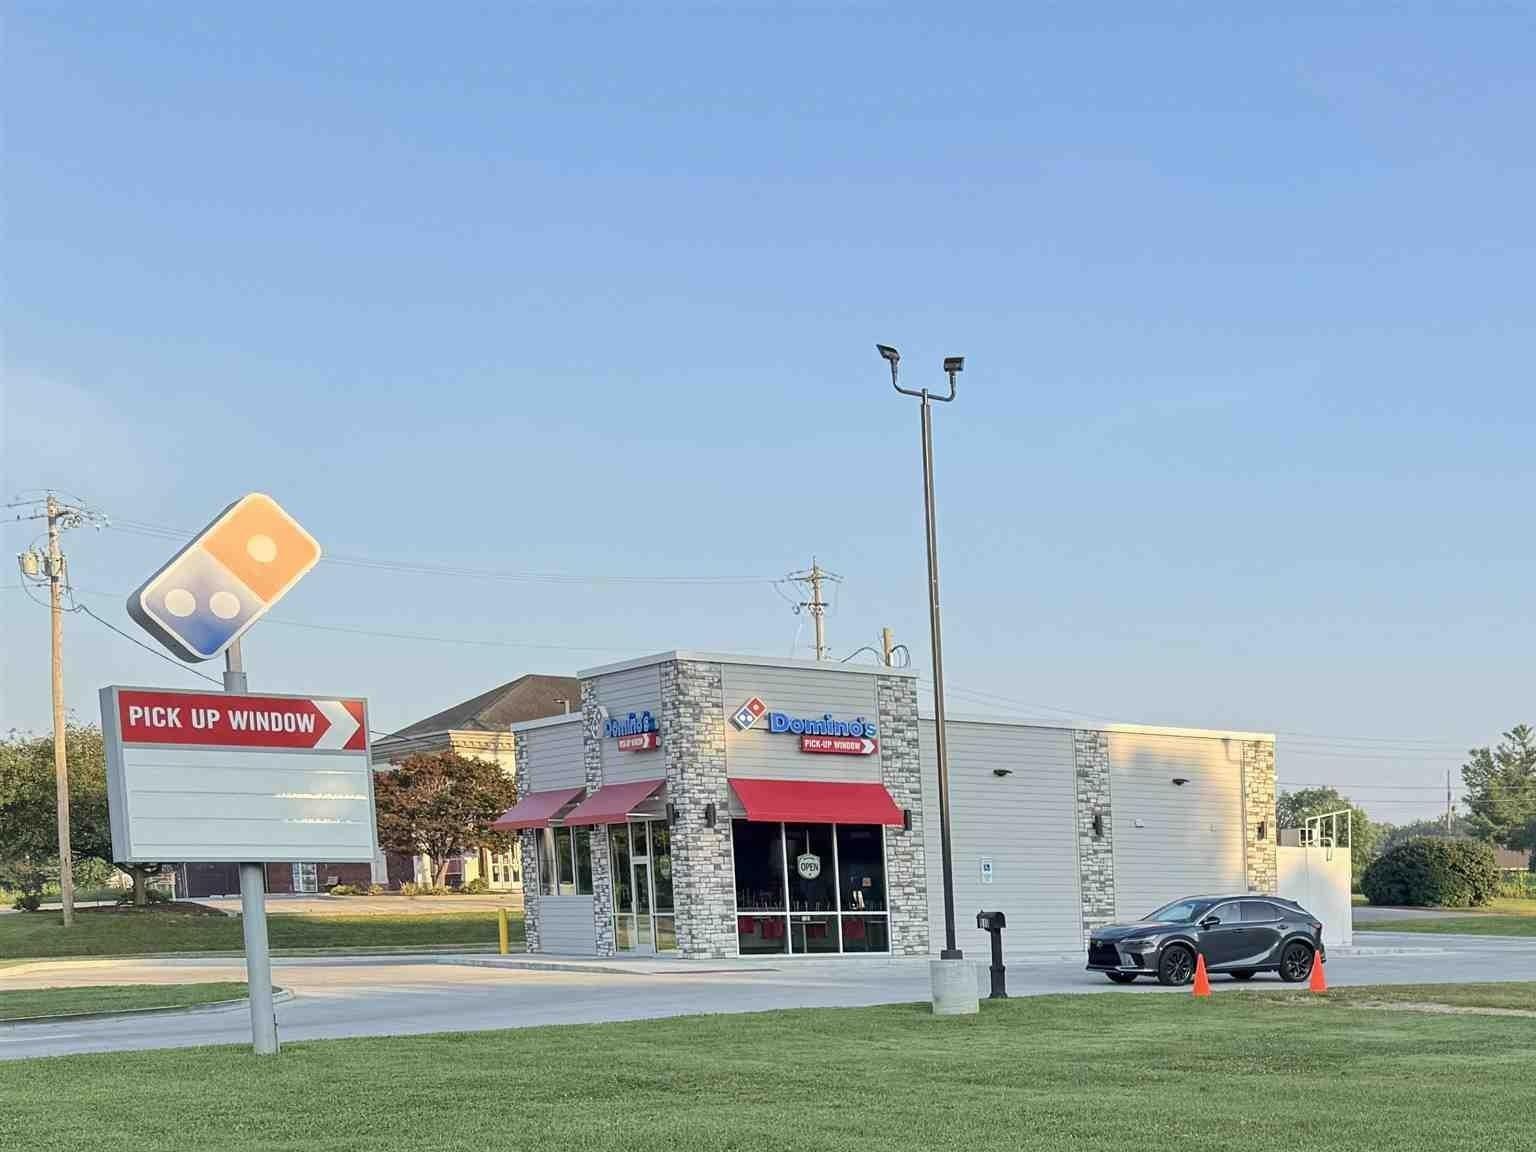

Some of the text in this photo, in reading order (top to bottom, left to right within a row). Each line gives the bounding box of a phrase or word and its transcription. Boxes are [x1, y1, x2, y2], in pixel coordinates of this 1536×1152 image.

[128, 705, 316, 733] PICK UP WINDOW
[769, 711, 877, 737] Domino's
[804, 739, 861, 750] PICK-UP WINDOW
[800, 862, 819, 872] OPEN
